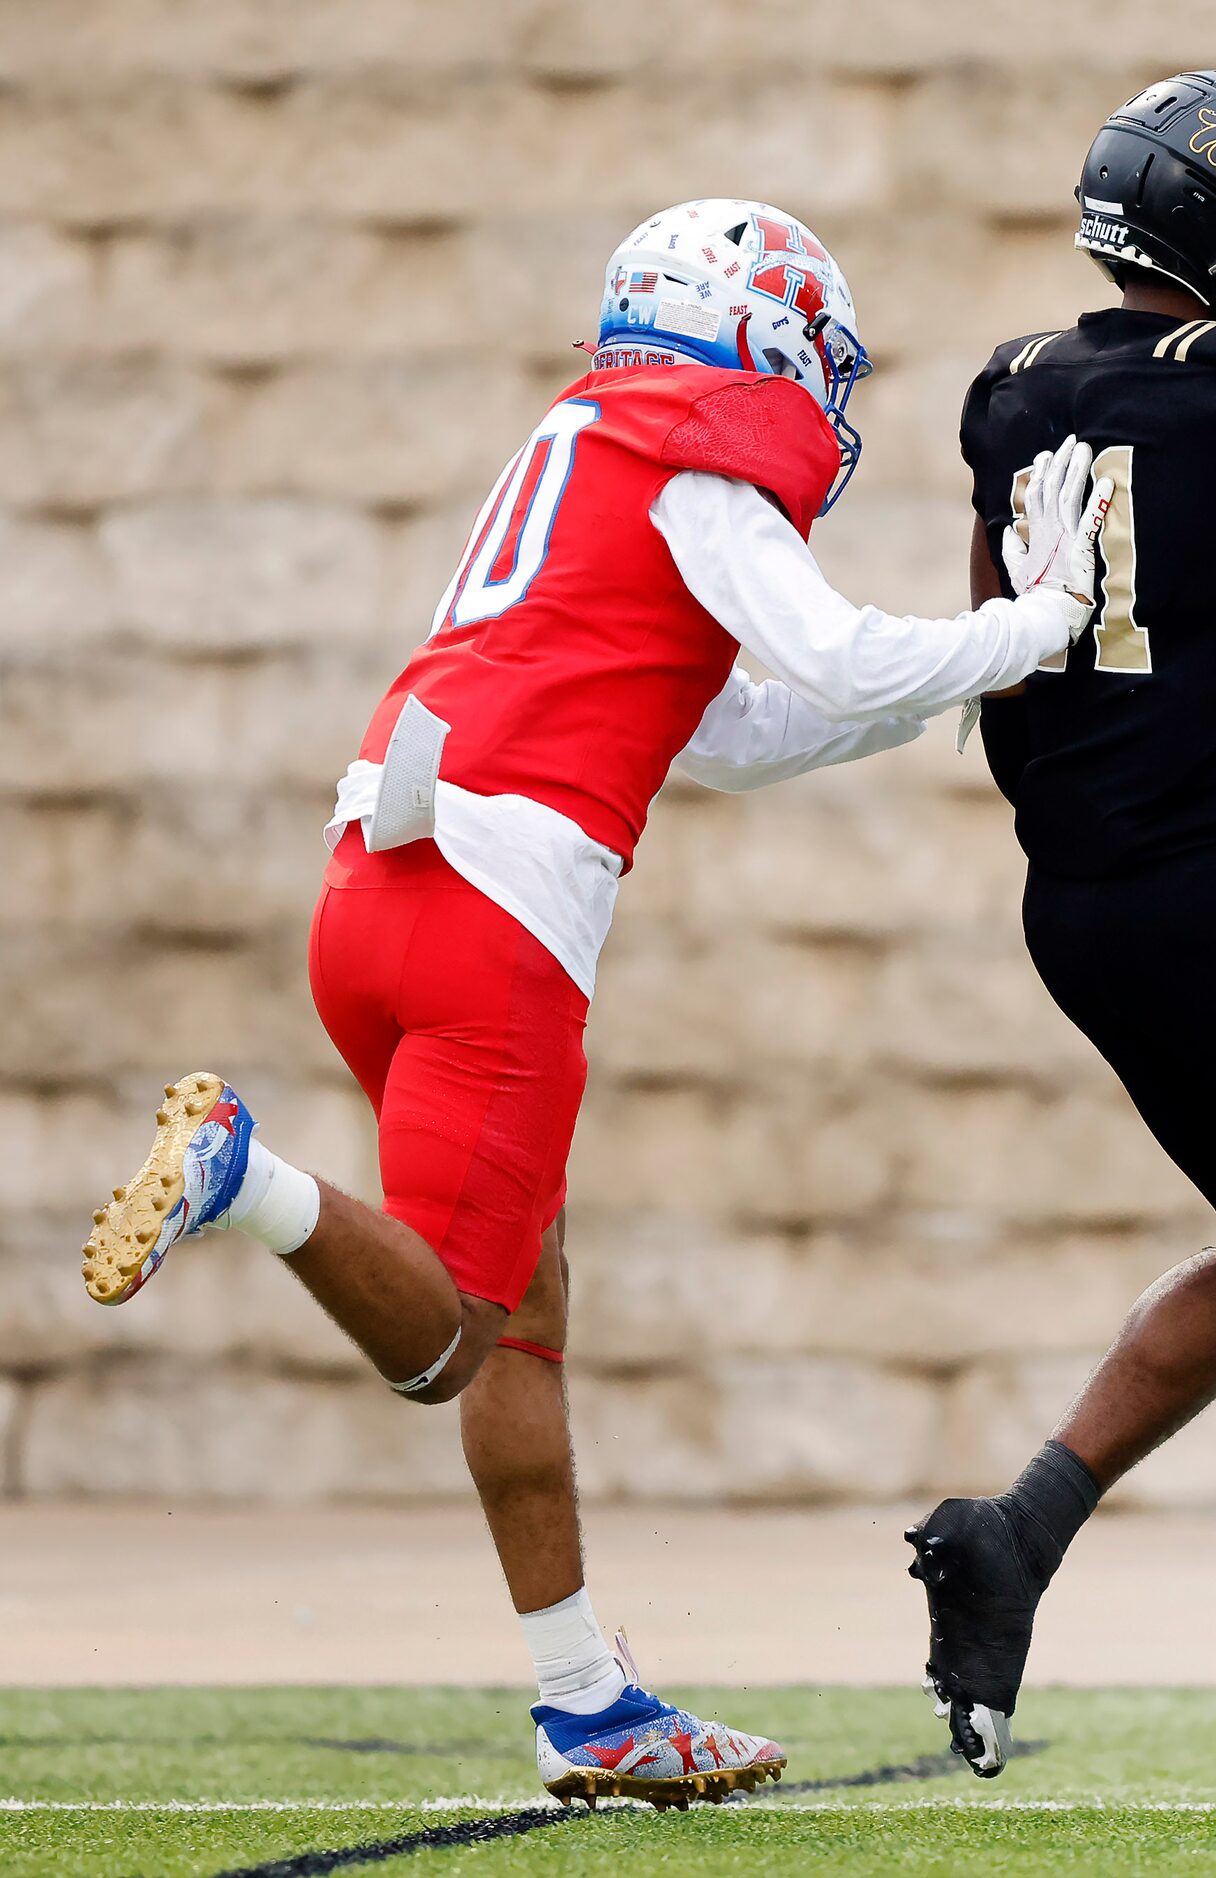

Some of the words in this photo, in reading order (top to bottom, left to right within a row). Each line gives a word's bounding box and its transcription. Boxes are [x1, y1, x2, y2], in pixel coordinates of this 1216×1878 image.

[1080, 215, 1129, 245] schutt
[723, 261, 741, 279] FEAST
[695, 280, 711, 293] ARE
[700, 289, 713, 300] WE
[627, 303, 654, 325] CW
[729, 304, 748, 316] FEAST
[771, 316, 790, 331] GUYS
[796, 349, 812, 367] FEAST
